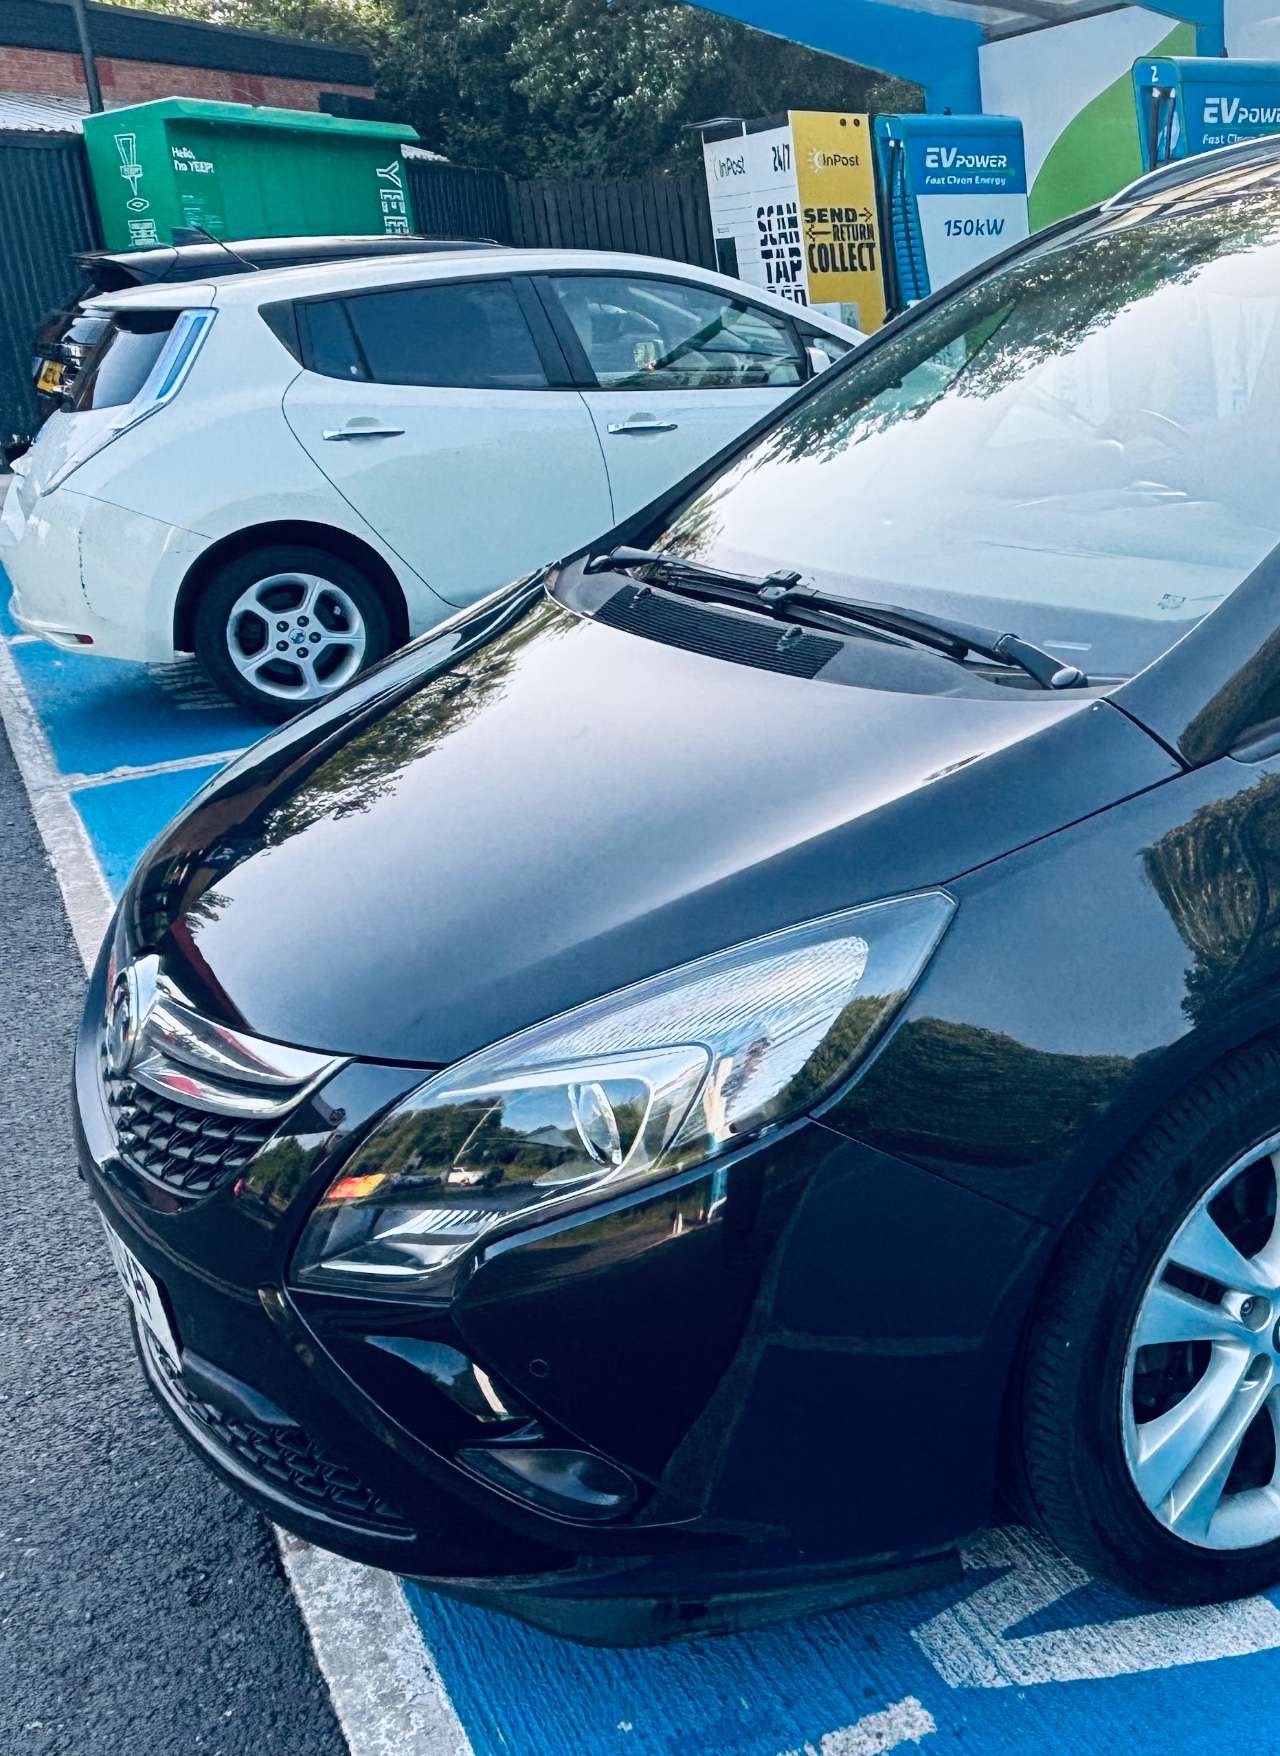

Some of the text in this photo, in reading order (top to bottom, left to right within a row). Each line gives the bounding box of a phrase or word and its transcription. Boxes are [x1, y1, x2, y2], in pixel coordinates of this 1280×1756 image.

[1150, 65, 1159, 83] 2
[1202, 133, 1225, 145] Fast
[718, 155, 746, 178] InPost
[823, 153, 860, 166] InPost
[925, 175, 946, 185] Fast
[803, 207, 858, 224] SEND
[832, 223, 875, 242] RETURN
[944, 218, 1005, 237] 150kW
[808, 242, 876, 274] COLLECT
